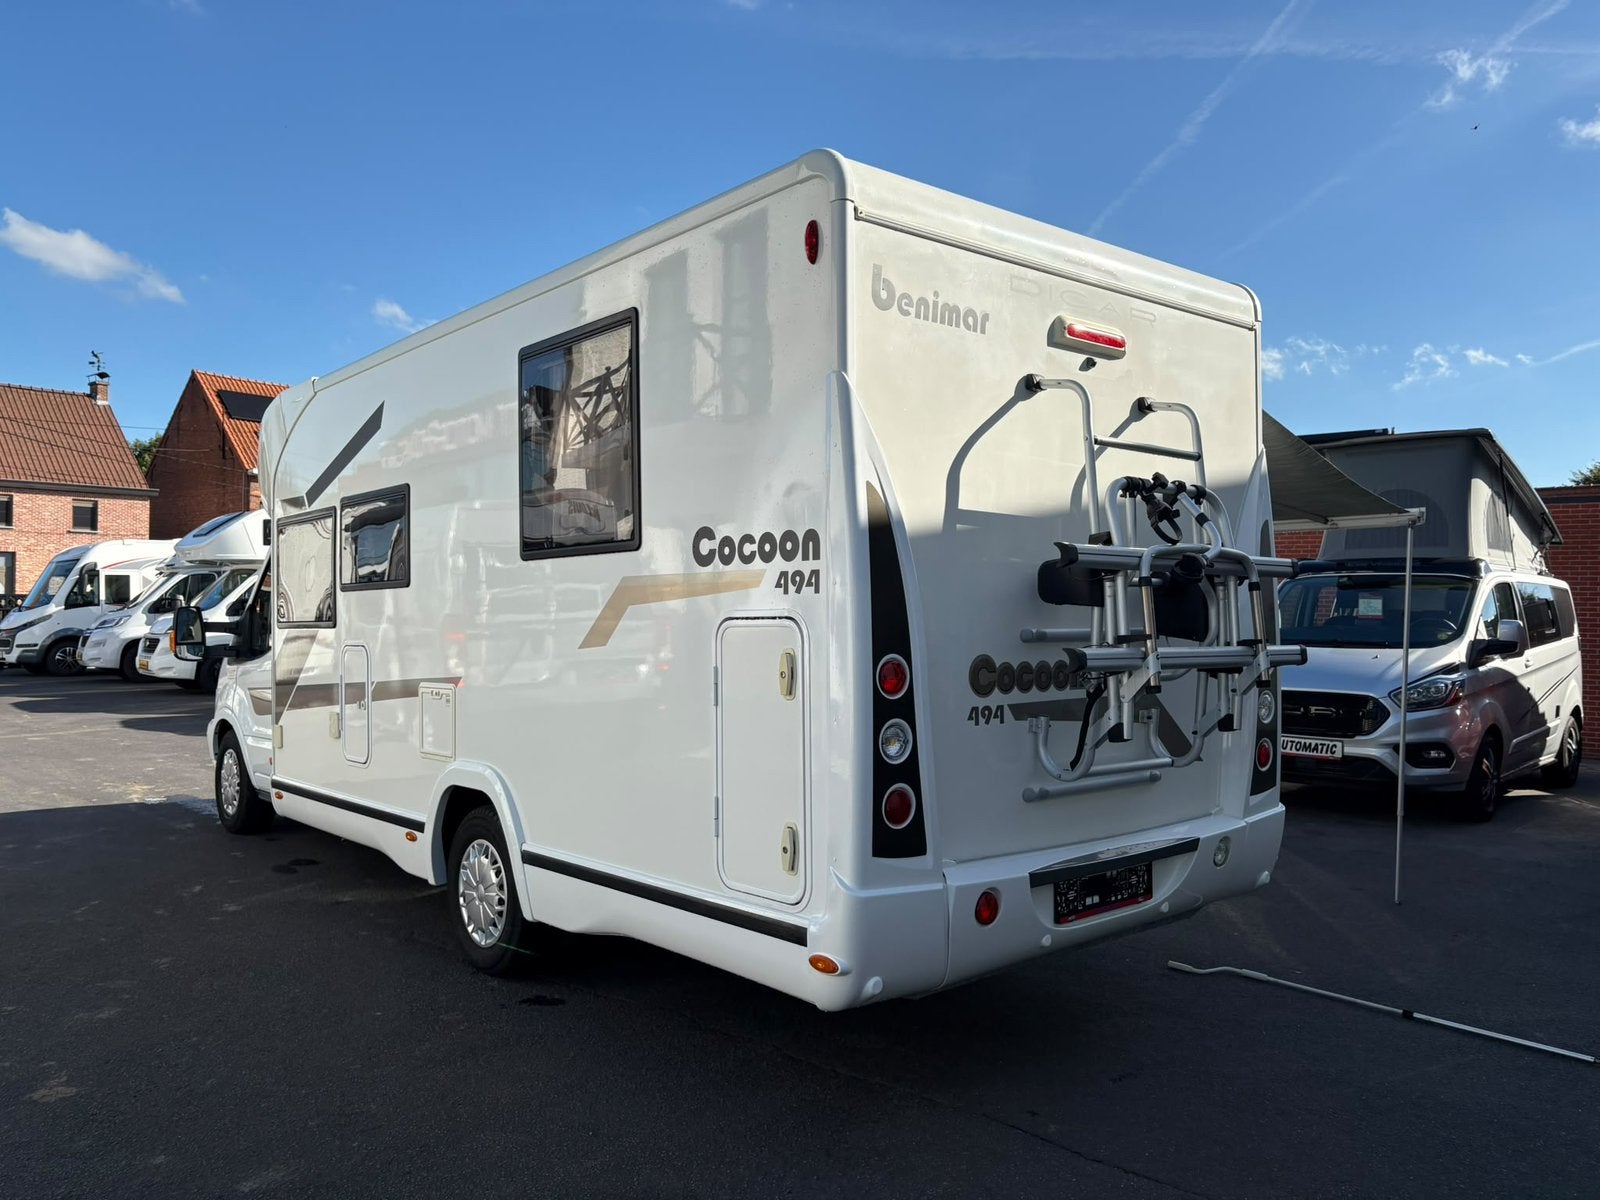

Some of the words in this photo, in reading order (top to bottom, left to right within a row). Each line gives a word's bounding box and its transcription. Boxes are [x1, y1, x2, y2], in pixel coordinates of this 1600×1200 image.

[872, 263, 990, 335] benimar
[692, 526, 821, 567] Cocoon
[774, 569, 820, 595] 494
[967, 705, 1005, 726] 494
[1281, 739, 1338, 755] UTOMATIC
